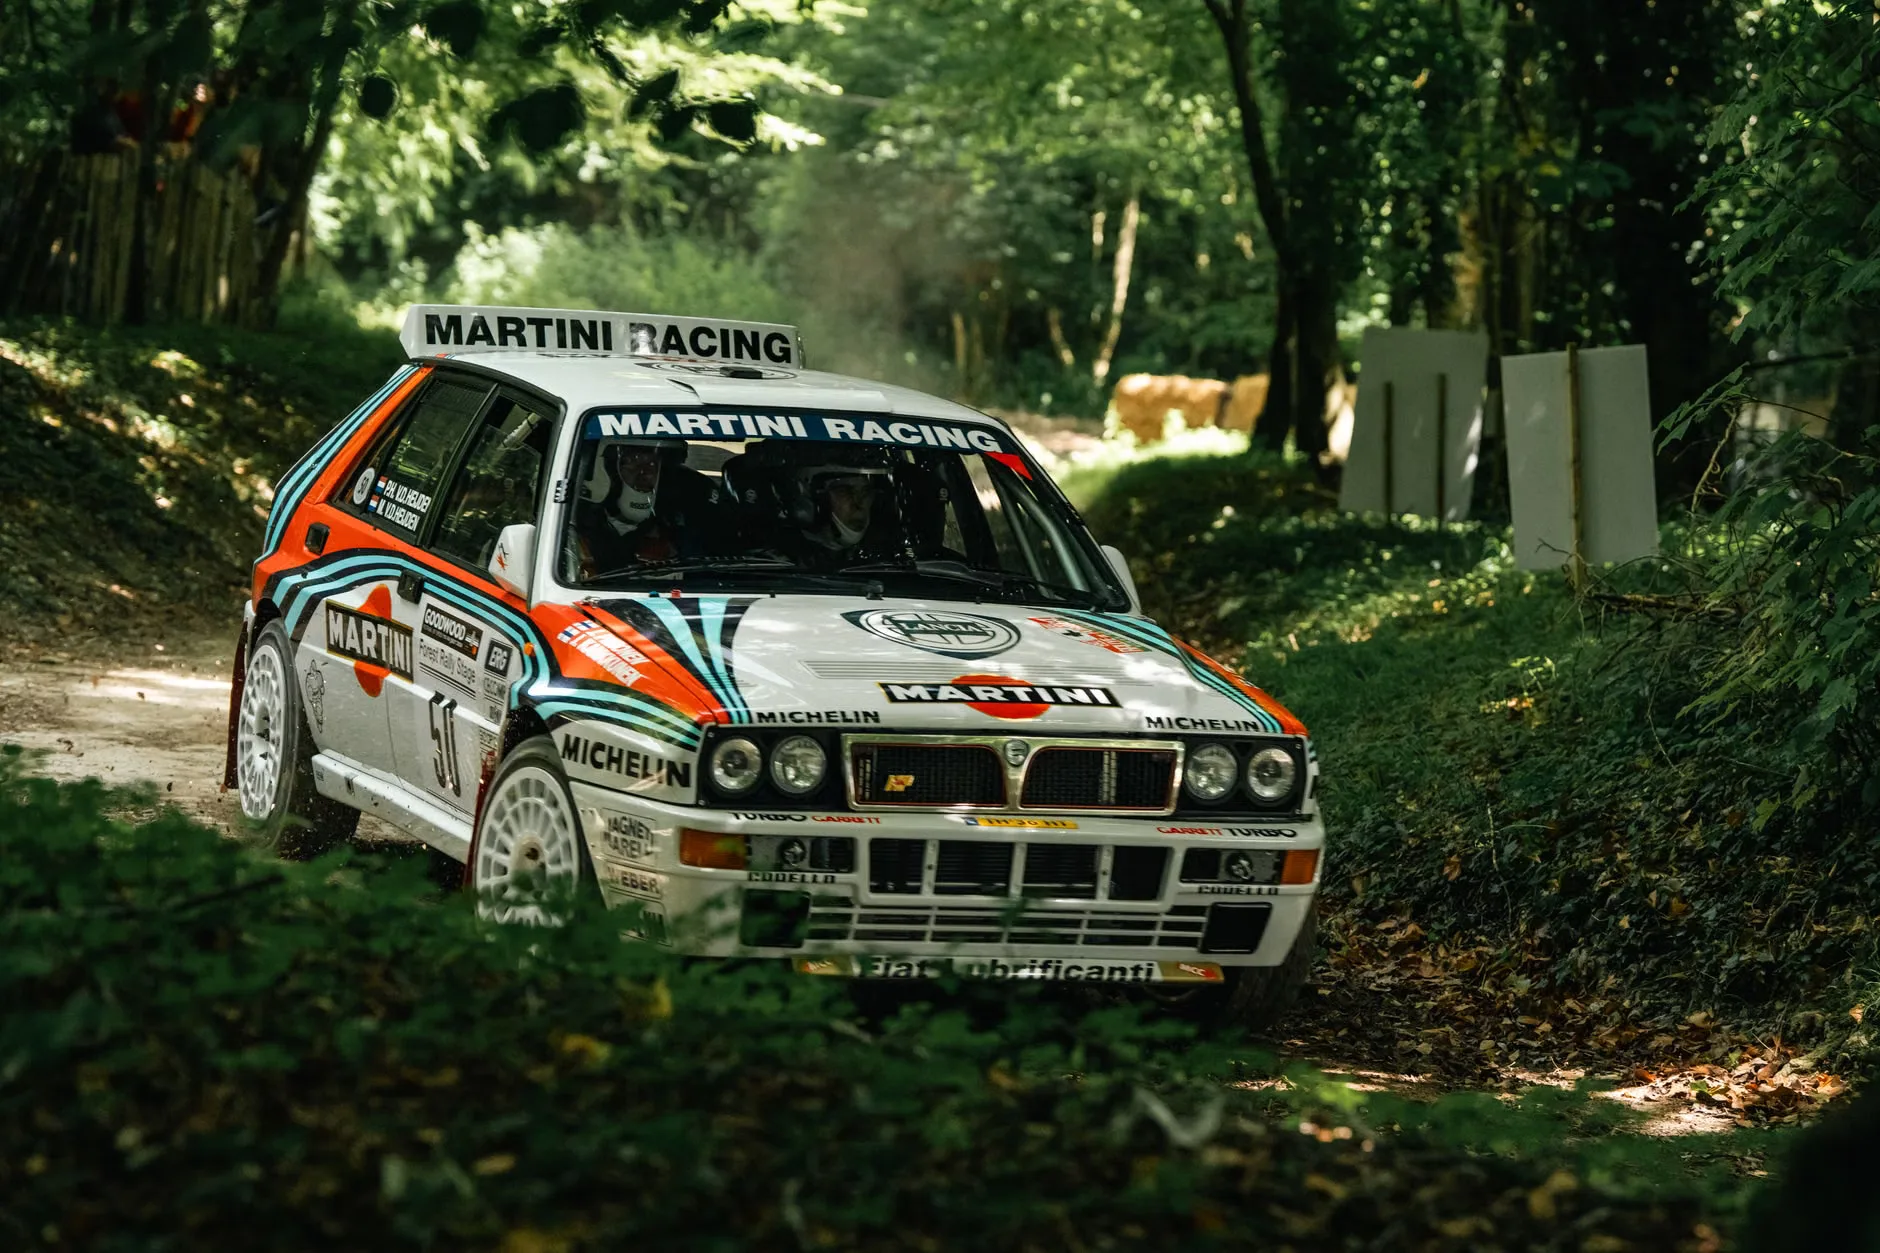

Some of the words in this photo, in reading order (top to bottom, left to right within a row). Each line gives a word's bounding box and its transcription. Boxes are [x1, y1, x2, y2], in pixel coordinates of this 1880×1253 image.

[425, 314, 613, 351] MARTINI
[629, 322, 792, 364] RACING
[597, 413, 809, 438] MARTINI
[822, 417, 1004, 454] RACING
[424, 608, 466, 640] GOODWOOD
[900, 621, 982, 632] LANCIA
[328, 609, 411, 675] MARTINI
[420, 637, 438, 663] Forest
[440, 648, 455, 675] Rally
[457, 657, 476, 684] Stage
[488, 645, 508, 671] ERG
[887, 684, 1112, 705] MARTINI
[756, 711, 881, 724] MICHELIN
[1145, 716, 1259, 732] MICHELIN
[562, 733, 691, 788] MICHELIN
[730, 812, 807, 822] TURBO
[811, 815, 881, 825] GARRETT
[1157, 826, 1223, 836] GARRETT
[1222, 828, 1297, 838] TURBO
[942, 957, 1154, 983] ubrificanti
